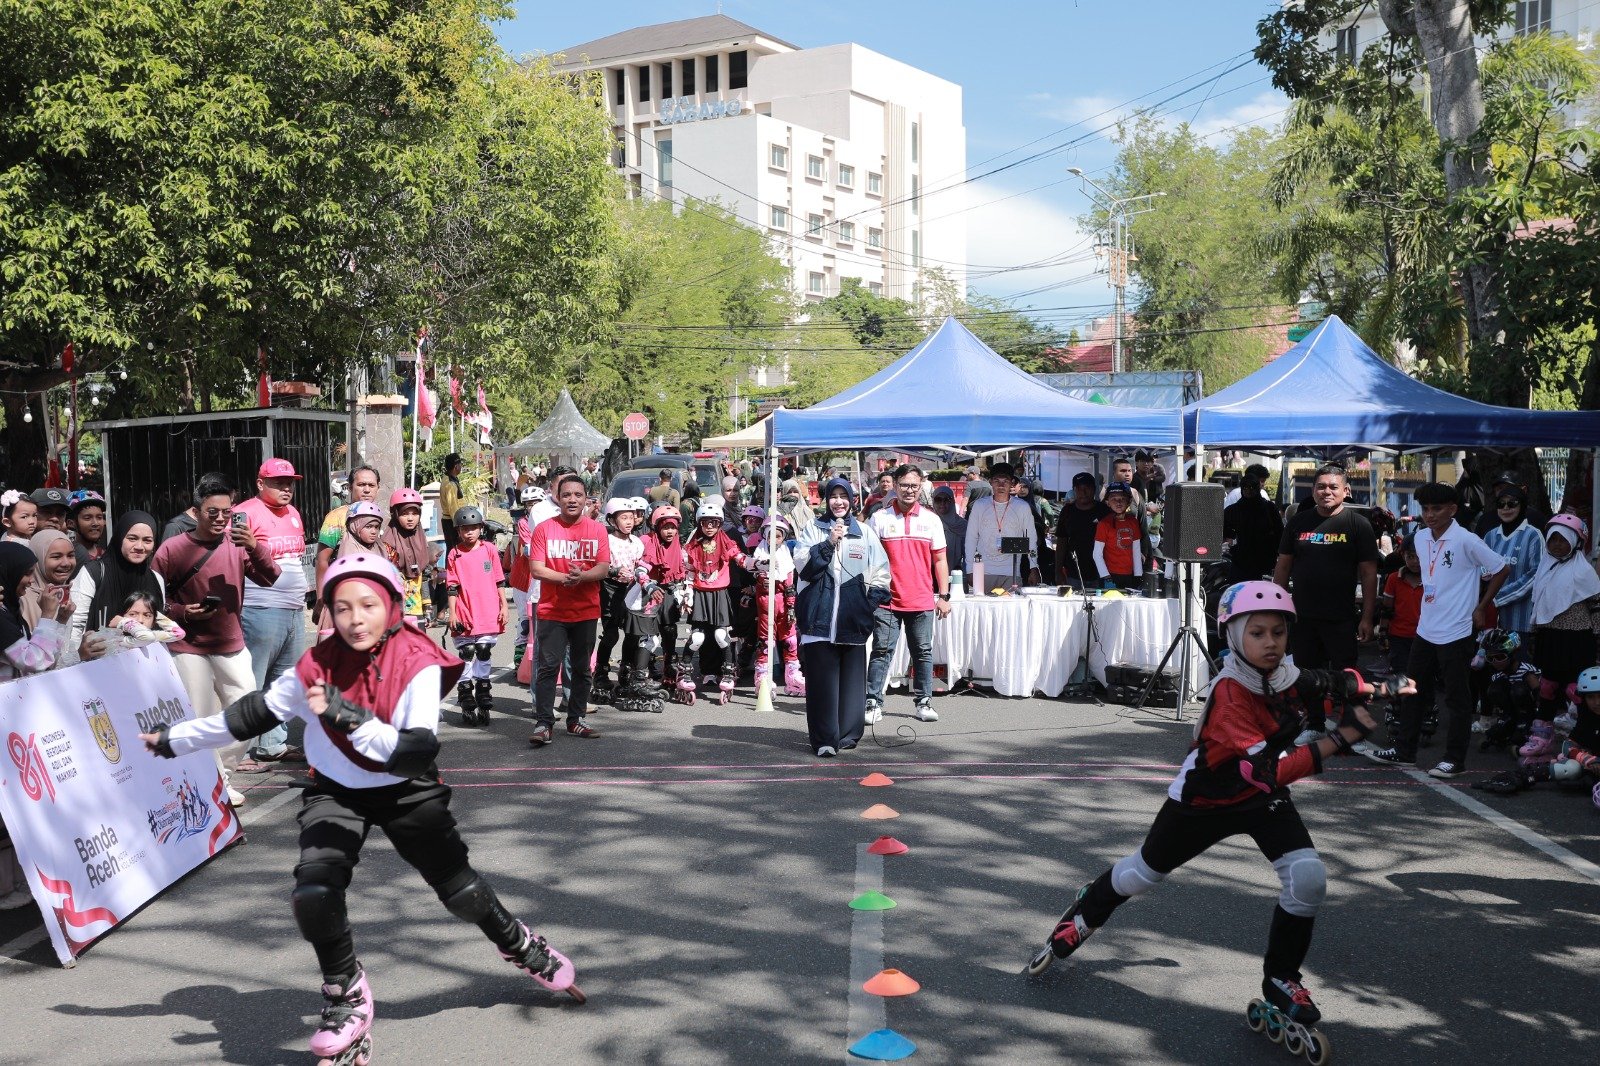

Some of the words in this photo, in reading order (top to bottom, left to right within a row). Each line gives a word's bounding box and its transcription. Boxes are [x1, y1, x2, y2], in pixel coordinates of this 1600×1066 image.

[625, 421, 648, 431] STOP
[1298, 532, 1347, 543] DISPORA
[547, 539, 599, 562] MARVEL
[41, 729, 66, 745] INDONESIA
[46, 741, 72, 758] BERDAULAT
[56, 767, 77, 783] MAKMUR
[74, 824, 119, 863] Banda
[86, 851, 121, 889] Aceh
